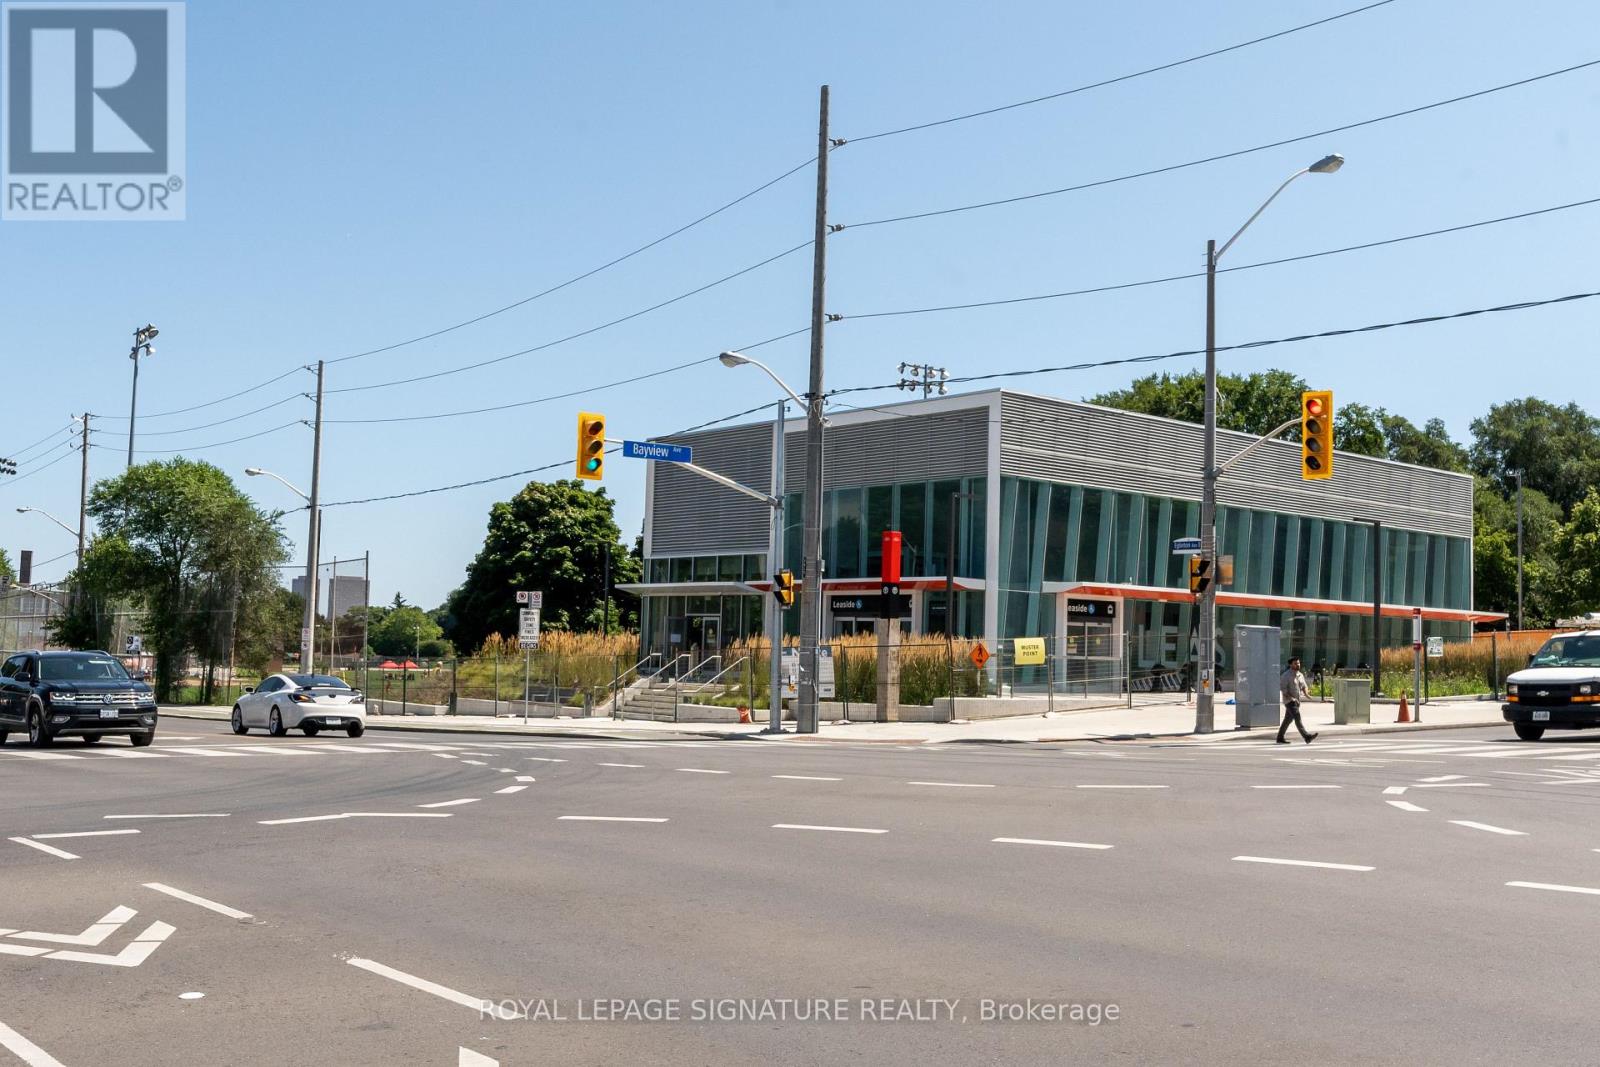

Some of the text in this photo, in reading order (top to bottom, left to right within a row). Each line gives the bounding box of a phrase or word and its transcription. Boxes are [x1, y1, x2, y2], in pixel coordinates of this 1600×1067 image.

[633, 443, 669, 458] Bayview
[833, 601, 855, 609] Leaside
[1067, 603, 1088, 613] easide
